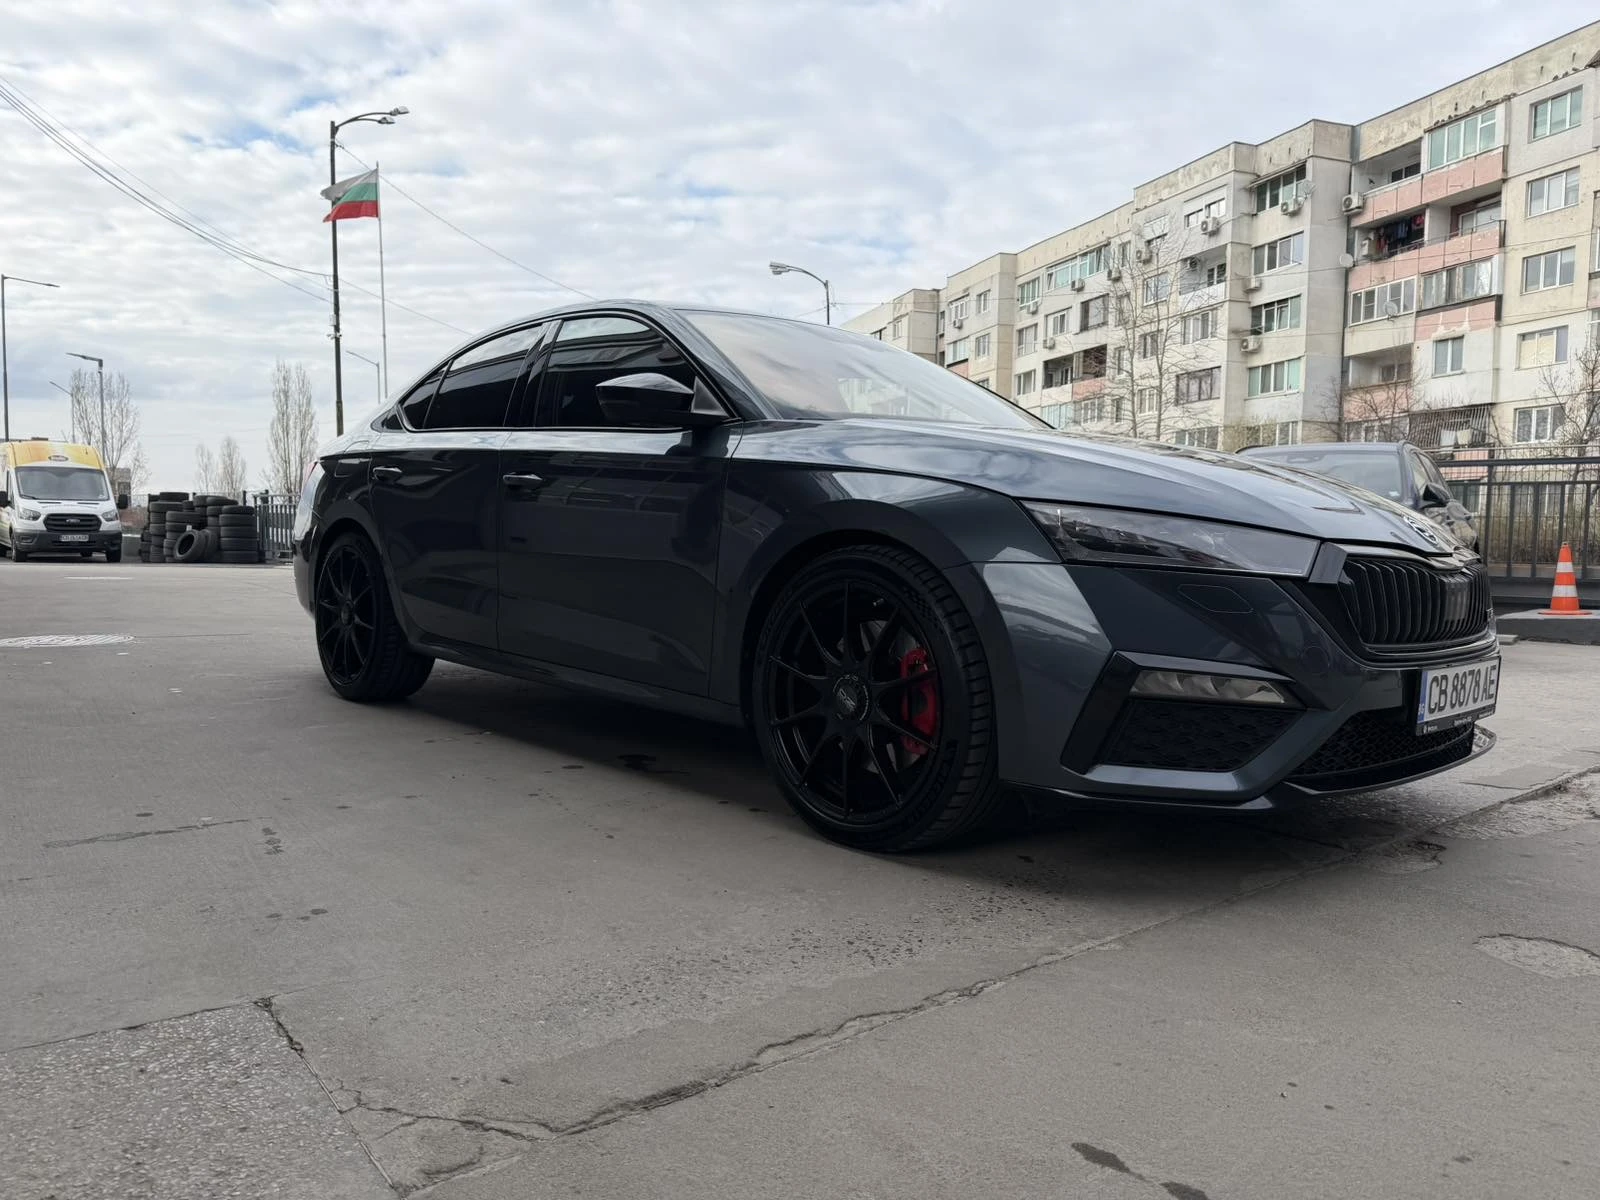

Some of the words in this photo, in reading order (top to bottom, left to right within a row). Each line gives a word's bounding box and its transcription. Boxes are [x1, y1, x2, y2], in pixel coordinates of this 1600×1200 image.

[1428, 675, 1449, 714] CB
[1450, 669, 1481, 709] 8878
[1481, 665, 1497, 701] AE
